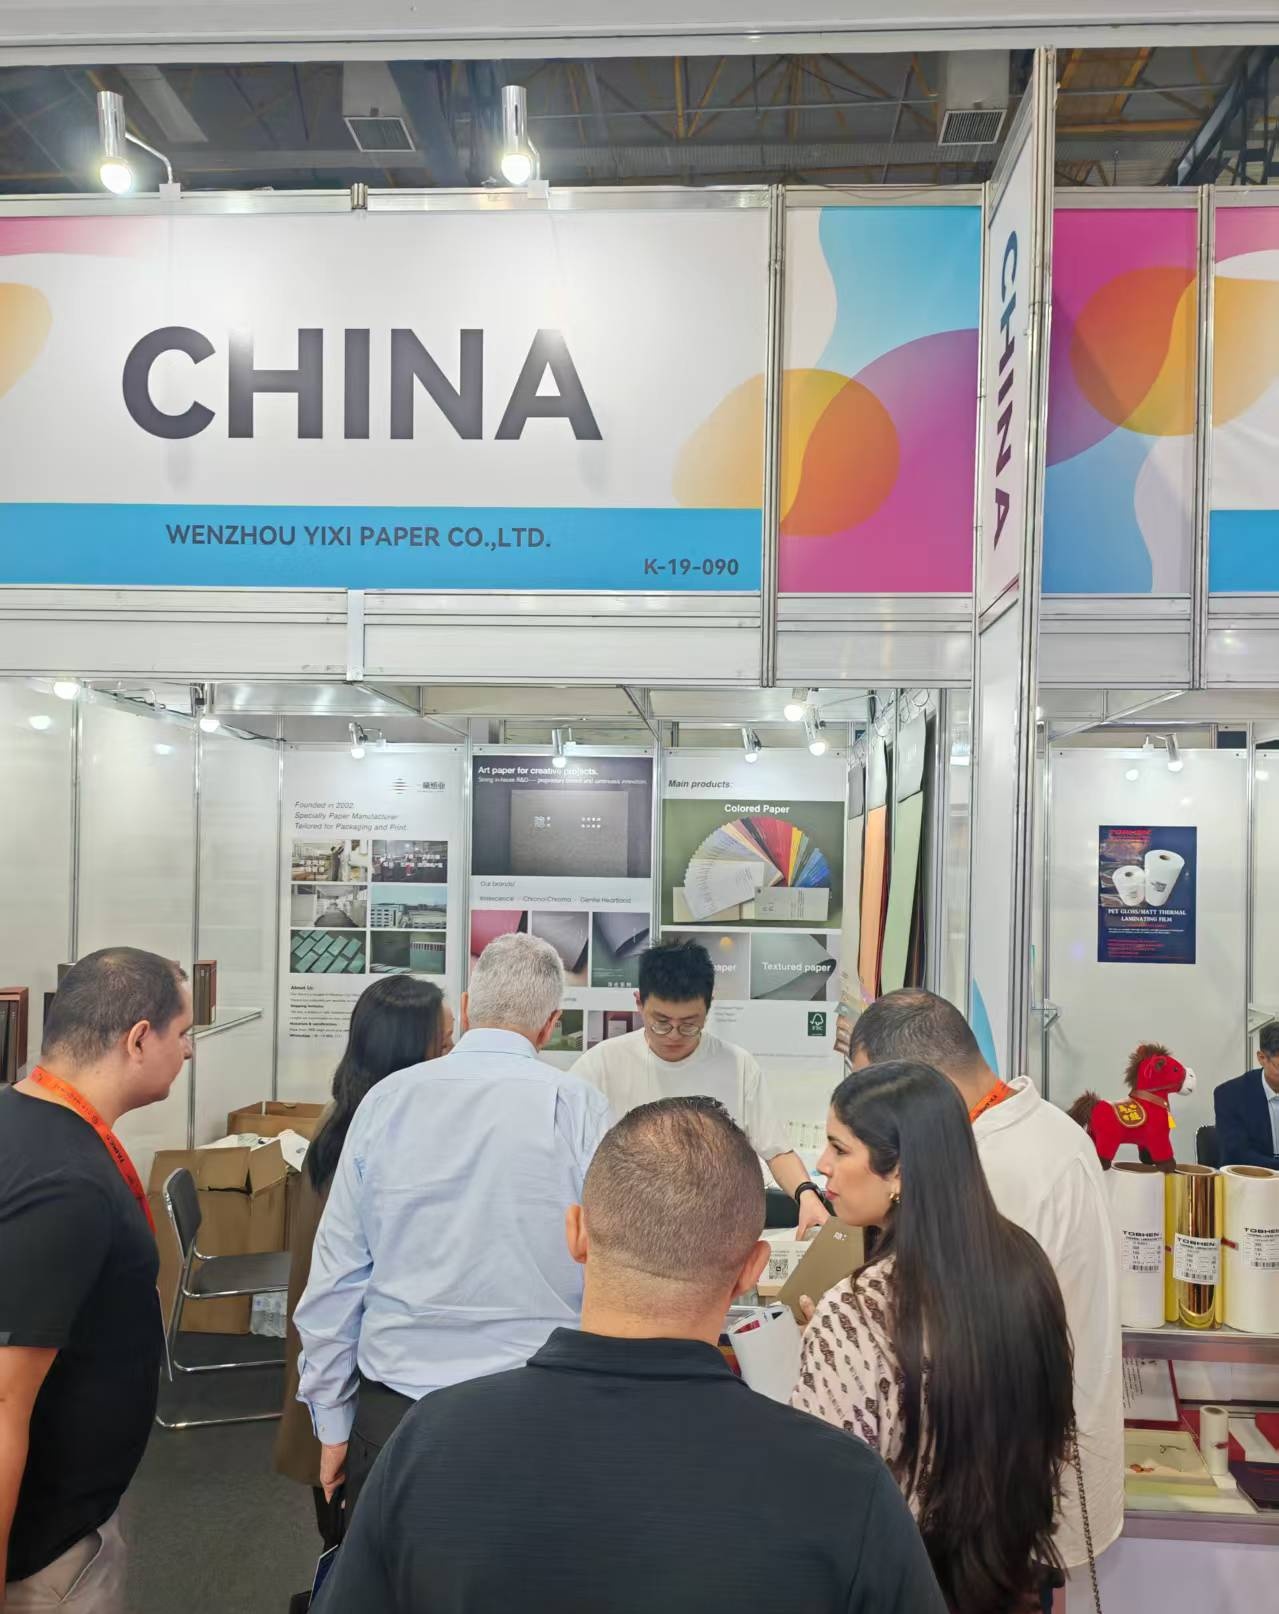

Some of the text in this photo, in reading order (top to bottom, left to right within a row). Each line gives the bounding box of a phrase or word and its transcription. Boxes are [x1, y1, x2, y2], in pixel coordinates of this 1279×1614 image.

[121, 325, 604, 441] CHINA
[993, 228, 1018, 552] CHINA
[165, 523, 552, 551] WENZHOU YIXI PAPER CO.,LTD.
[643, 557, 740, 576] K-19-090
[478, 766, 491, 774] Art
[491, 767, 516, 776] paper
[517, 766, 530, 774] for
[668, 779, 689, 788] Main
[294, 801, 327, 809] Founded
[724, 803, 790, 815] Colored Paper
[328, 812, 350, 820] Paper
[295, 822, 323, 830] Tailored
[335, 824, 373, 832] Packaging
[762, 961, 832, 973] Textured paper
